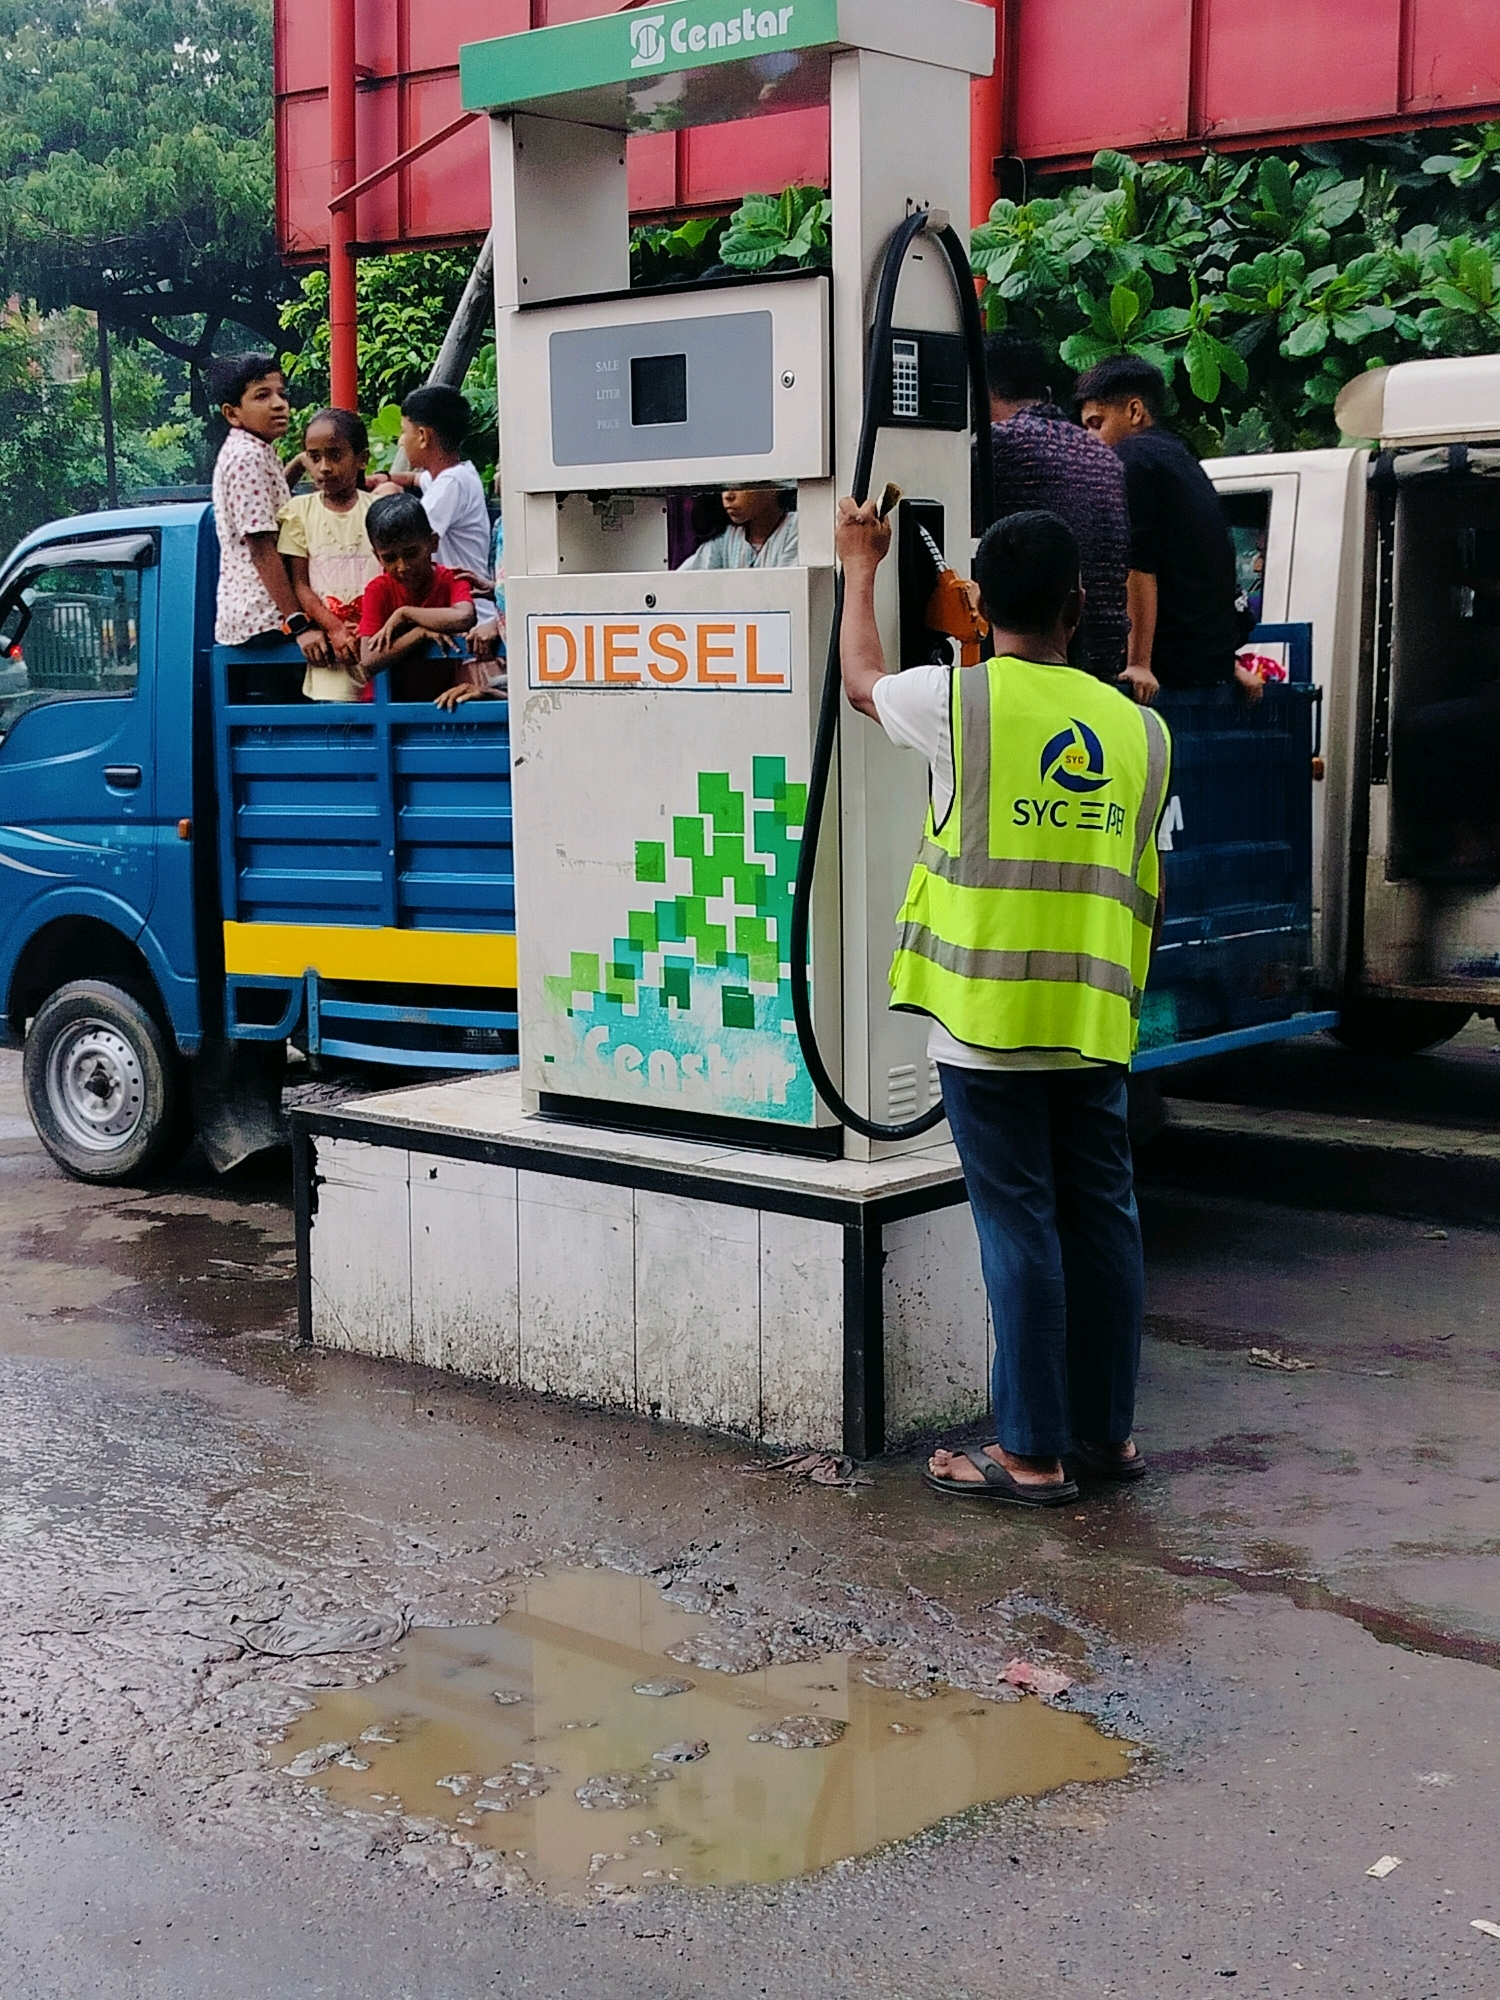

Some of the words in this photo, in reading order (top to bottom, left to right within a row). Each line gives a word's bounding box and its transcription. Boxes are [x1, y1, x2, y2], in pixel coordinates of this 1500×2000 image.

[670, 5, 794, 54] Censtar
[595, 360, 620, 373] SALE
[596, 388, 621, 400] LITER
[596, 419, 621, 430] PRICE
[536, 624, 785, 684] DIESEL
[1065, 755, 1085, 765] SYC
[1012, 798, 1069, 828] SYC
[583, 1025, 797, 1104] Censtar
